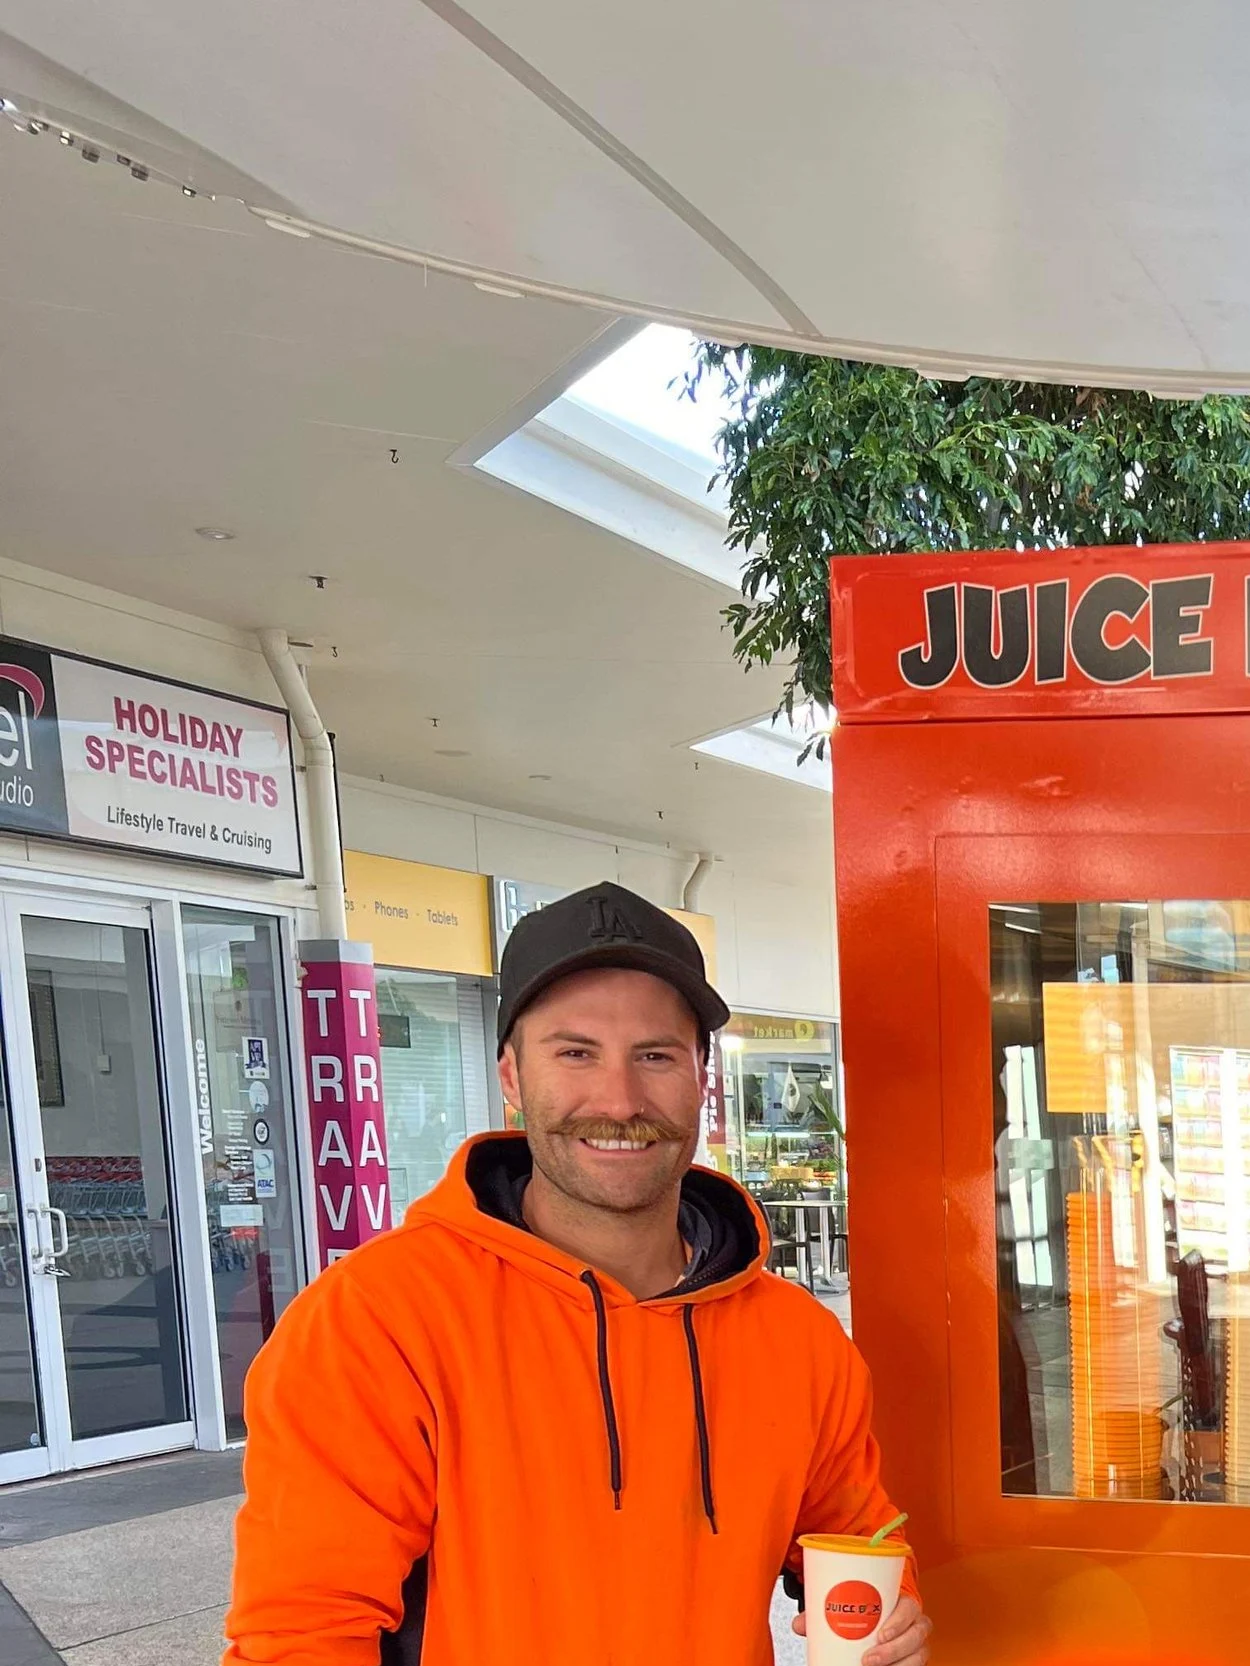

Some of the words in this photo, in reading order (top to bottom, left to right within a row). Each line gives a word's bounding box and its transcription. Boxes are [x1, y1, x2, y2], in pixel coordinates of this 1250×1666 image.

[898, 573, 1214, 690] JUICE
[113, 695, 244, 759] HOLIDAY
[84, 734, 279, 808] SPECIALISTS
[106, 805, 164, 834] Lifestyle
[167, 816, 207, 841] Travel
[209, 825, 220, 841] &
[222, 827, 272, 854] Cruising
[374, 900, 409, 920] Phones
[427, 909, 459, 926] Tablets
[195, 1038, 214, 1155] Welcome
